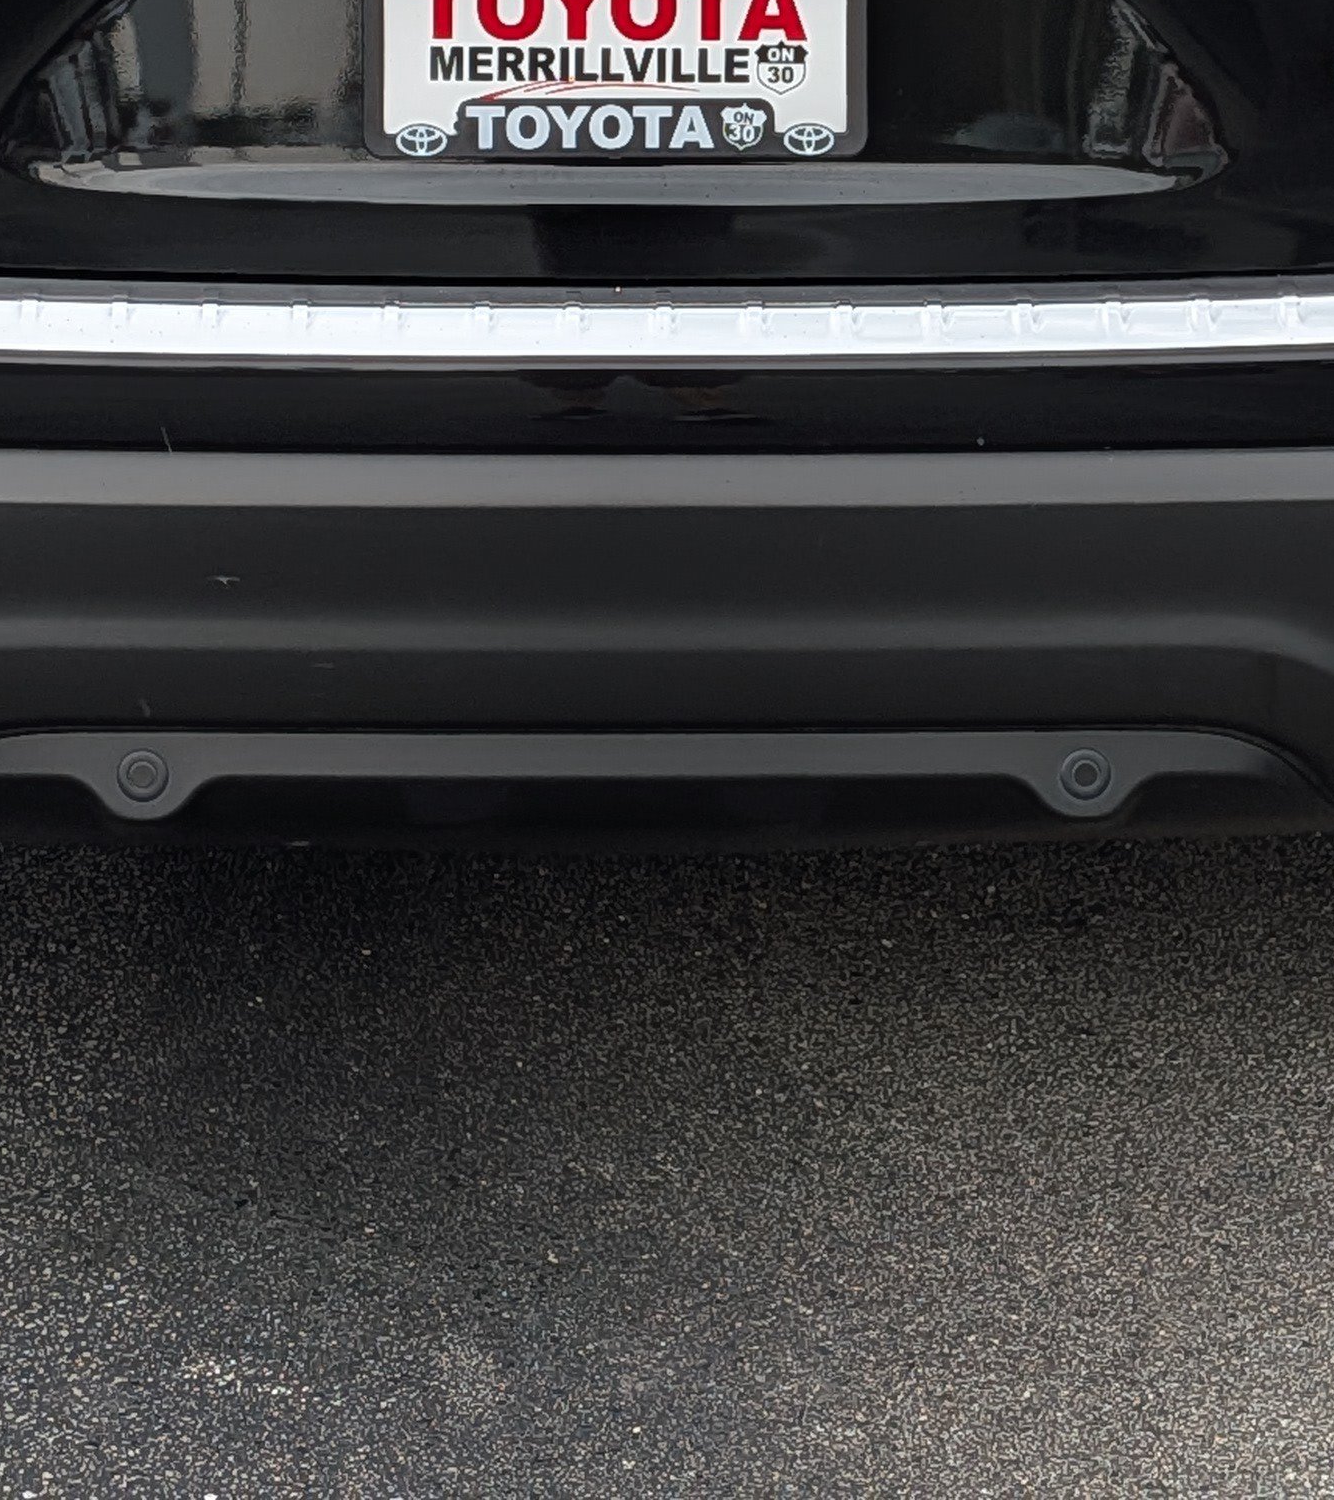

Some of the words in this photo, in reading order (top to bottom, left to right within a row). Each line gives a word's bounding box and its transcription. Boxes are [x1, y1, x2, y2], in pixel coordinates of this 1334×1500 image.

[768, 47, 796, 62] ON
[430, 45, 750, 84] MERRILLVILLE
[768, 66, 794, 84] 30
[733, 111, 755, 125] ON
[467, 105, 715, 150] TOYOTA
[729, 124, 755, 143] 30
